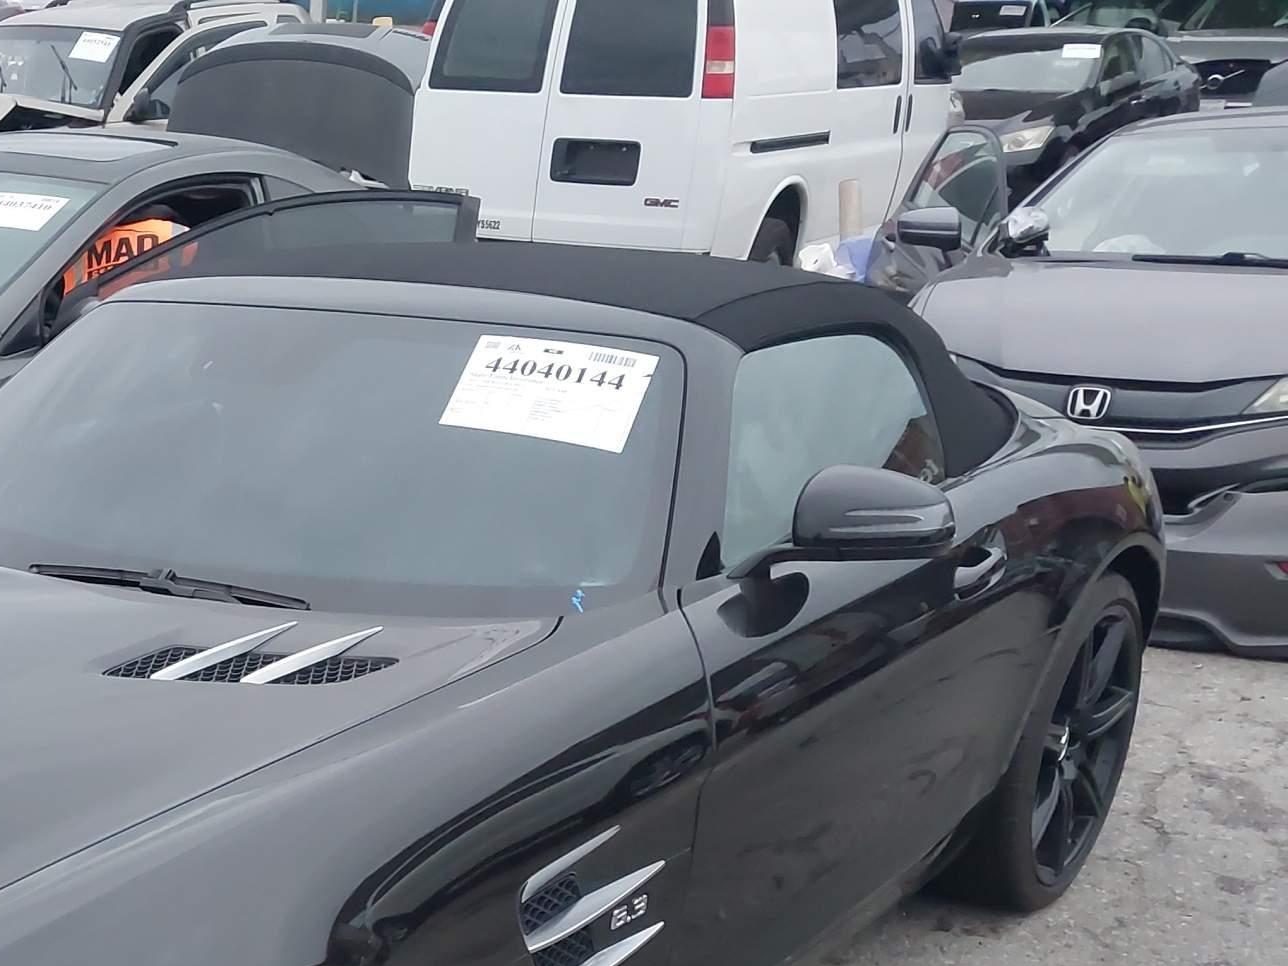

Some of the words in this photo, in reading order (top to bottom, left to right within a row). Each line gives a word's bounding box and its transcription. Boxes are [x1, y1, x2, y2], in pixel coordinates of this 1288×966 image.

[644, 198, 679, 209] GMC
[485, 357, 626, 390] 44040144
[611, 894, 648, 930] 6.3
